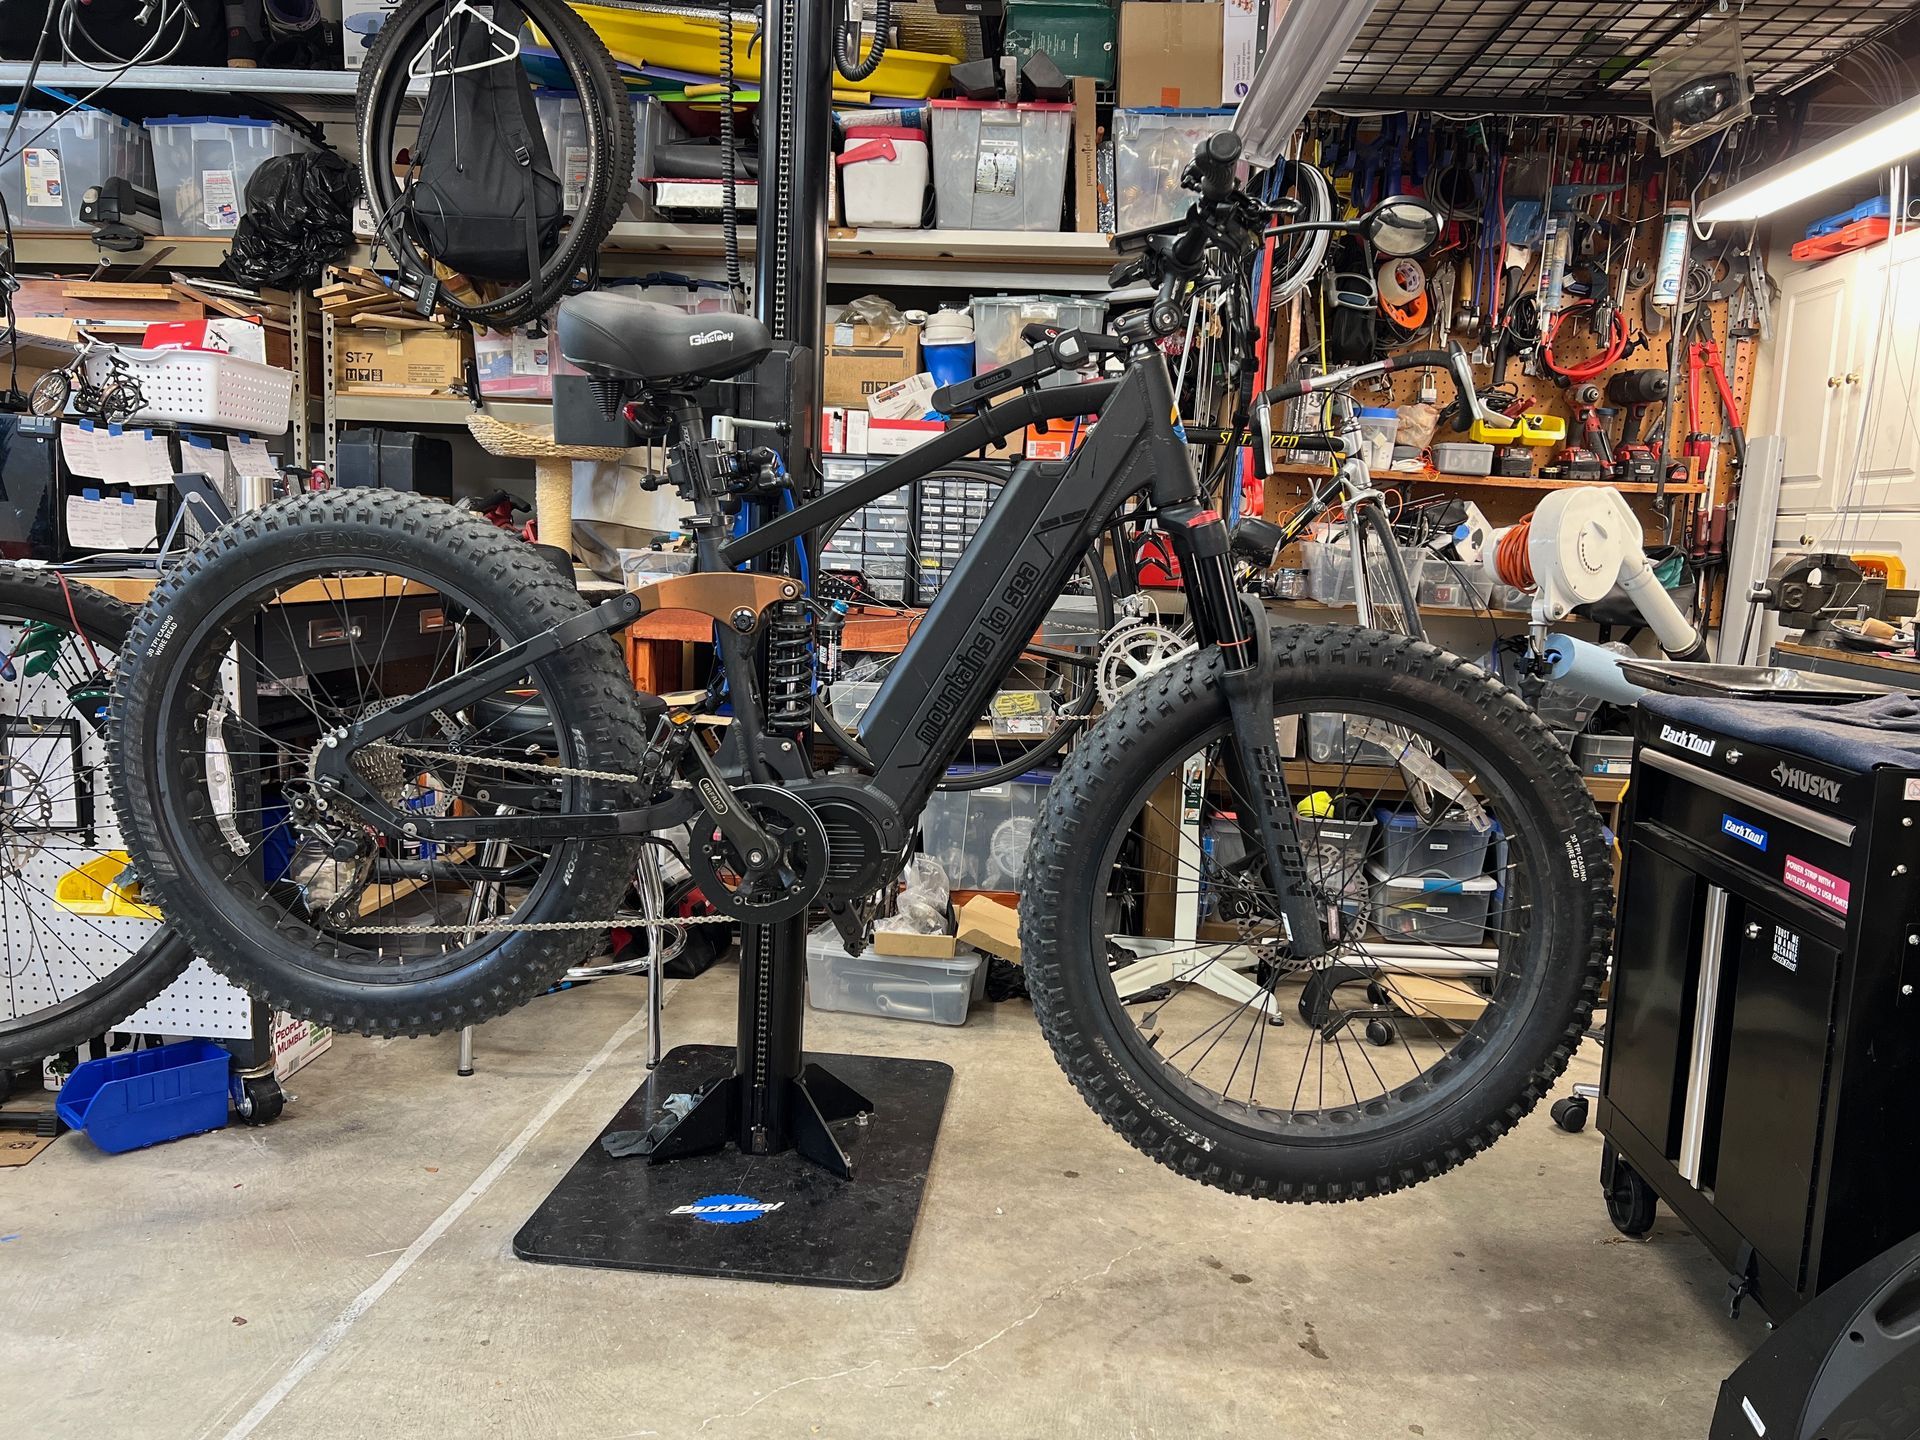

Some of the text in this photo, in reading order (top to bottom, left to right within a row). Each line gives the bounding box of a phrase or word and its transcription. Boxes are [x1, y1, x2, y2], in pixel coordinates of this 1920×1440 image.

[345, 352, 373, 363] ST-7
[291, 531, 410, 559] KENDA
[146, 614, 174, 658] 30 TPI CASING
[155, 622, 178, 656] WIRE BEAD
[914, 561, 1041, 746] mountains to sea
[702, 782, 725, 811] BAFANG
[1787, 767, 1843, 802] HUSKY
[1564, 840, 1580, 879] WIRE BEAD
[1570, 833, 1587, 882] 30 TPI CASING
[1786, 860, 1803, 873] POWER
[1804, 867, 1818, 880] STRIP
[1818, 875, 1832, 887] WITH
[1785, 872, 1806, 886] OUTLETS
[1805, 881, 1818, 893] AND
[1821, 890, 1832, 901] USB
[1831, 896, 1849, 910] PORTS
[1775, 925, 1800, 943] TRUST ME
[1782, 938, 1787, 948] A
[1787, 940, 1799, 954] BIKE
[1773, 943, 1797, 963] MECHANIC
